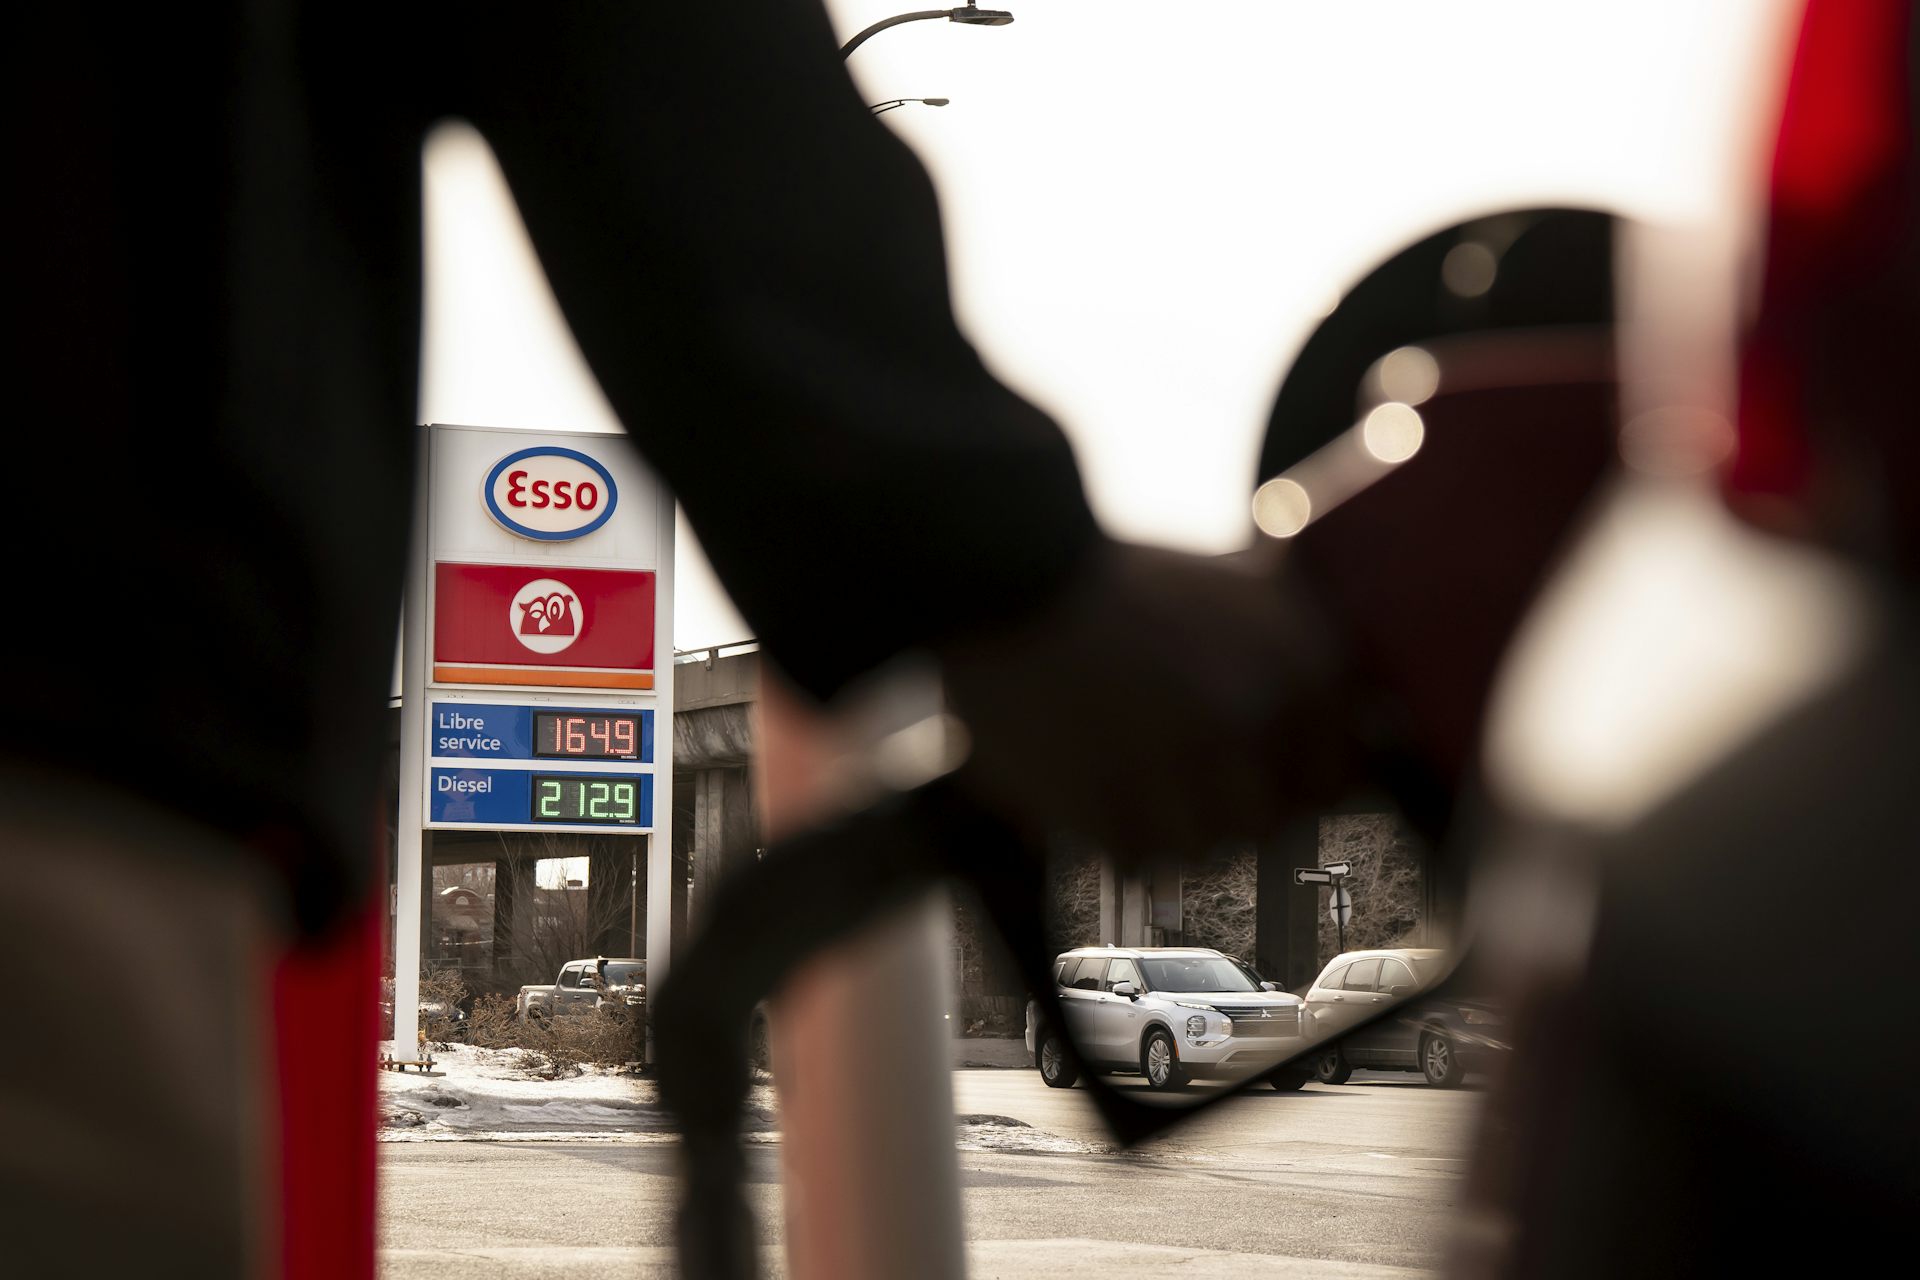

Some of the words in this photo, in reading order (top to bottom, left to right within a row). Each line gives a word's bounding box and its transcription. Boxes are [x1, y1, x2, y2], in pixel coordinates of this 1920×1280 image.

[439, 713, 484, 730] Libre
[439, 734, 501, 751] service
[555, 718, 634, 754] 164.9
[438, 775, 492, 793] Diesel
[541, 781, 634, 818] 212.9
